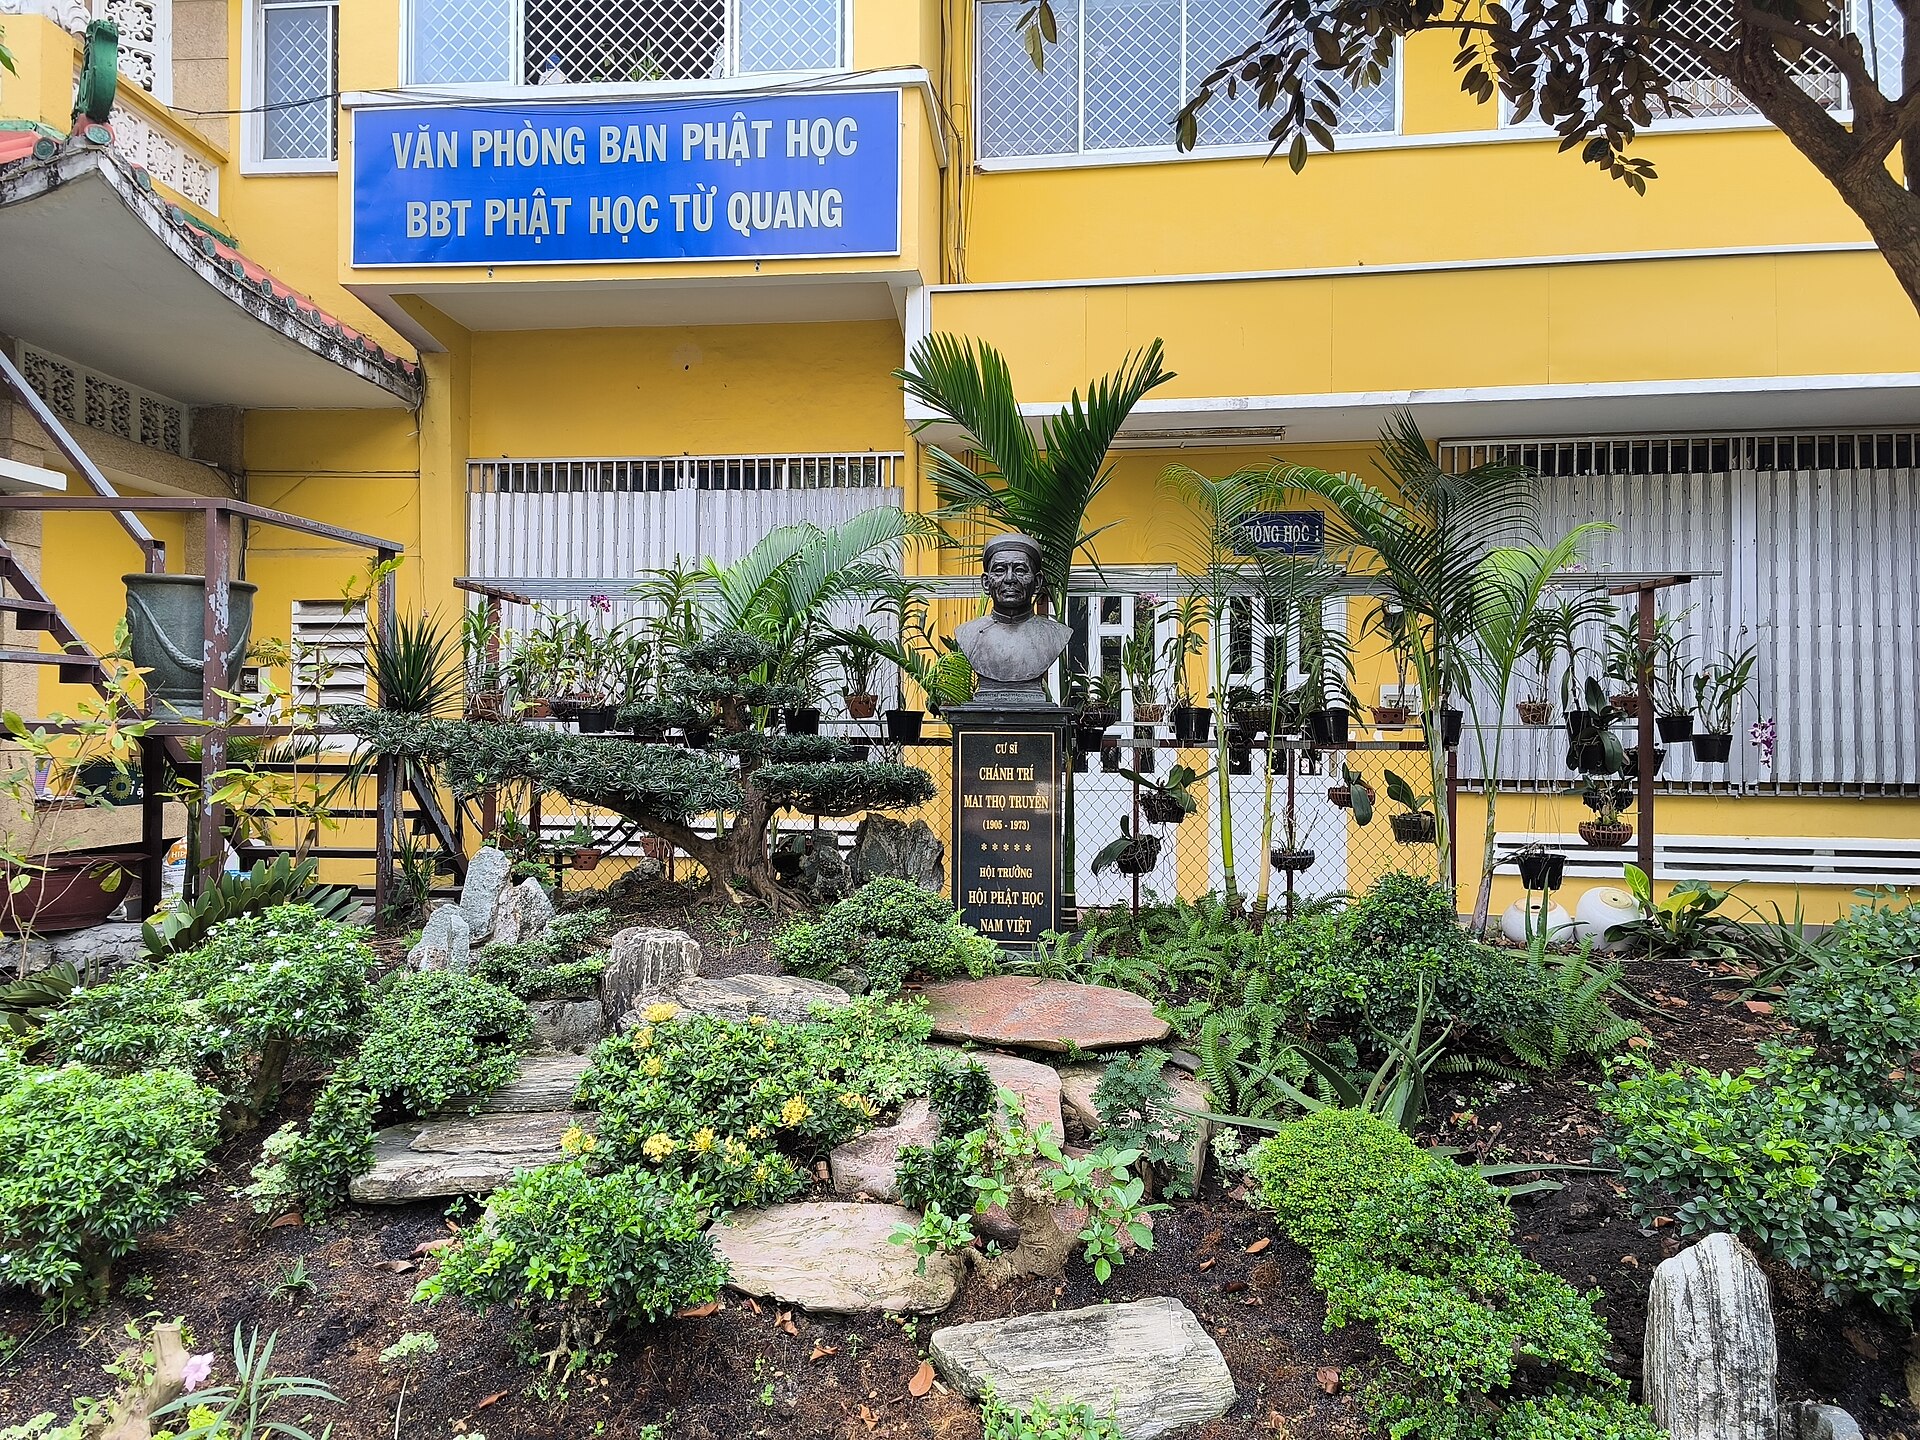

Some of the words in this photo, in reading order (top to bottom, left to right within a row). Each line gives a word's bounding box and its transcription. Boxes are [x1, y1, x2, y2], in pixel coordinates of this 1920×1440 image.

[392, 124, 458, 169] VĂN
[472, 119, 586, 167] PHÒNG
[599, 124, 667, 164] BAN
[682, 111, 773, 167] PHẬT
[786, 117, 858, 165] HỌC
[406, 199, 472, 238] BBT
[484, 187, 572, 244] PHẬT
[589, 195, 659, 243] HỌC
[669, 182, 718, 232] TỪ
[727, 188, 843, 237] QUANG
[995, 741, 1008, 754] CƯ
[979, 763, 1015, 780] CHÁNH
[1016, 764, 1034, 781] TRÍ
[963, 794, 983, 808] MAI
[985, 795, 1006, 811] THỌ
[1008, 789, 1049, 809] TRUYỀN
[979, 864, 996, 879] HỘI
[968, 887, 988, 907] HỘI
[990, 887, 1019, 908] PHẬT
[1021, 891, 1044, 908] HỌC
[980, 918, 1004, 932] NAM
[1006, 916, 1032, 936] VIỆT
